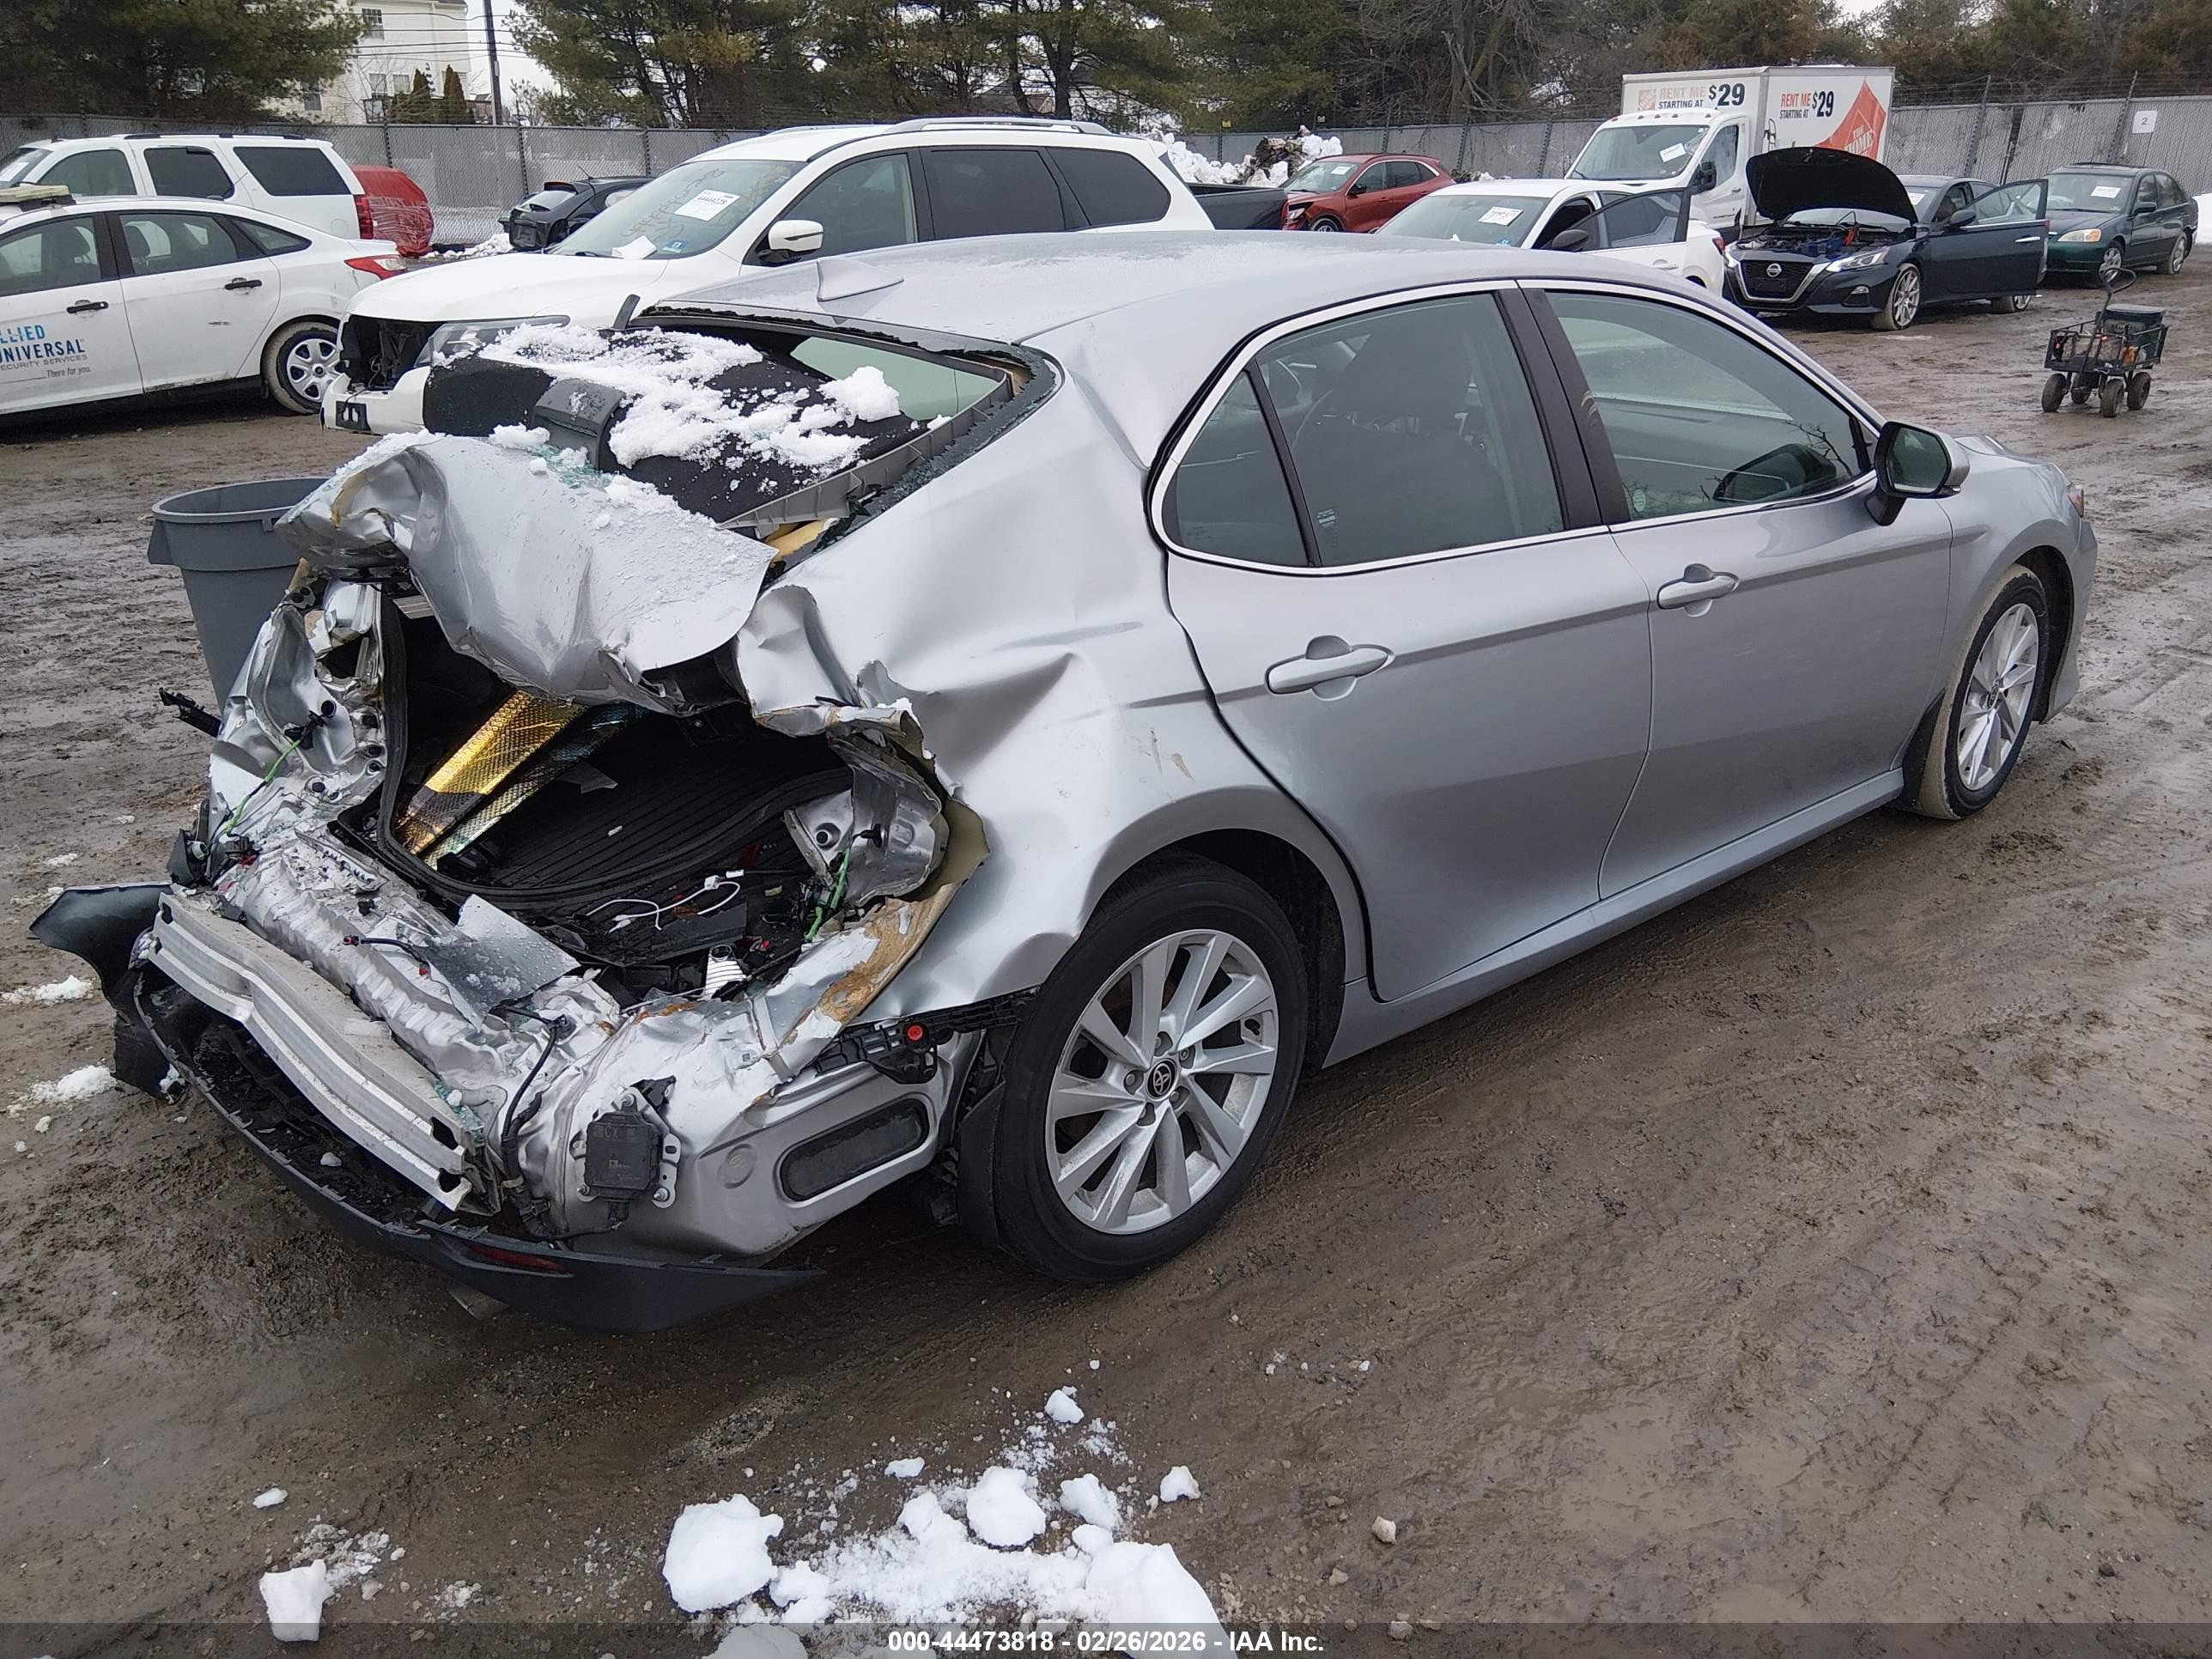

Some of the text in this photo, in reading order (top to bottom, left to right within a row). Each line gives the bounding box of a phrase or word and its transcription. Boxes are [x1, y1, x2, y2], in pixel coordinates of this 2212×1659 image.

[1659, 87, 1688, 100] RENT
[1689, 86, 1706, 98] ME
[1708, 83, 1746, 106] $29
[1658, 100, 1692, 109] STARTING
[1781, 90, 1834, 117] RENT ME $29
[1779, 109, 1808, 119] STARTING AT
[2141, 117, 2148, 125] 2
[1853, 125, 1864, 139] THE
[0, 325, 46, 343] LLIED
[0, 339, 85, 362] NIVERSAL
[0, 355, 88, 371] ECURITY SERVICES
[46, 369, 65, 379] There
